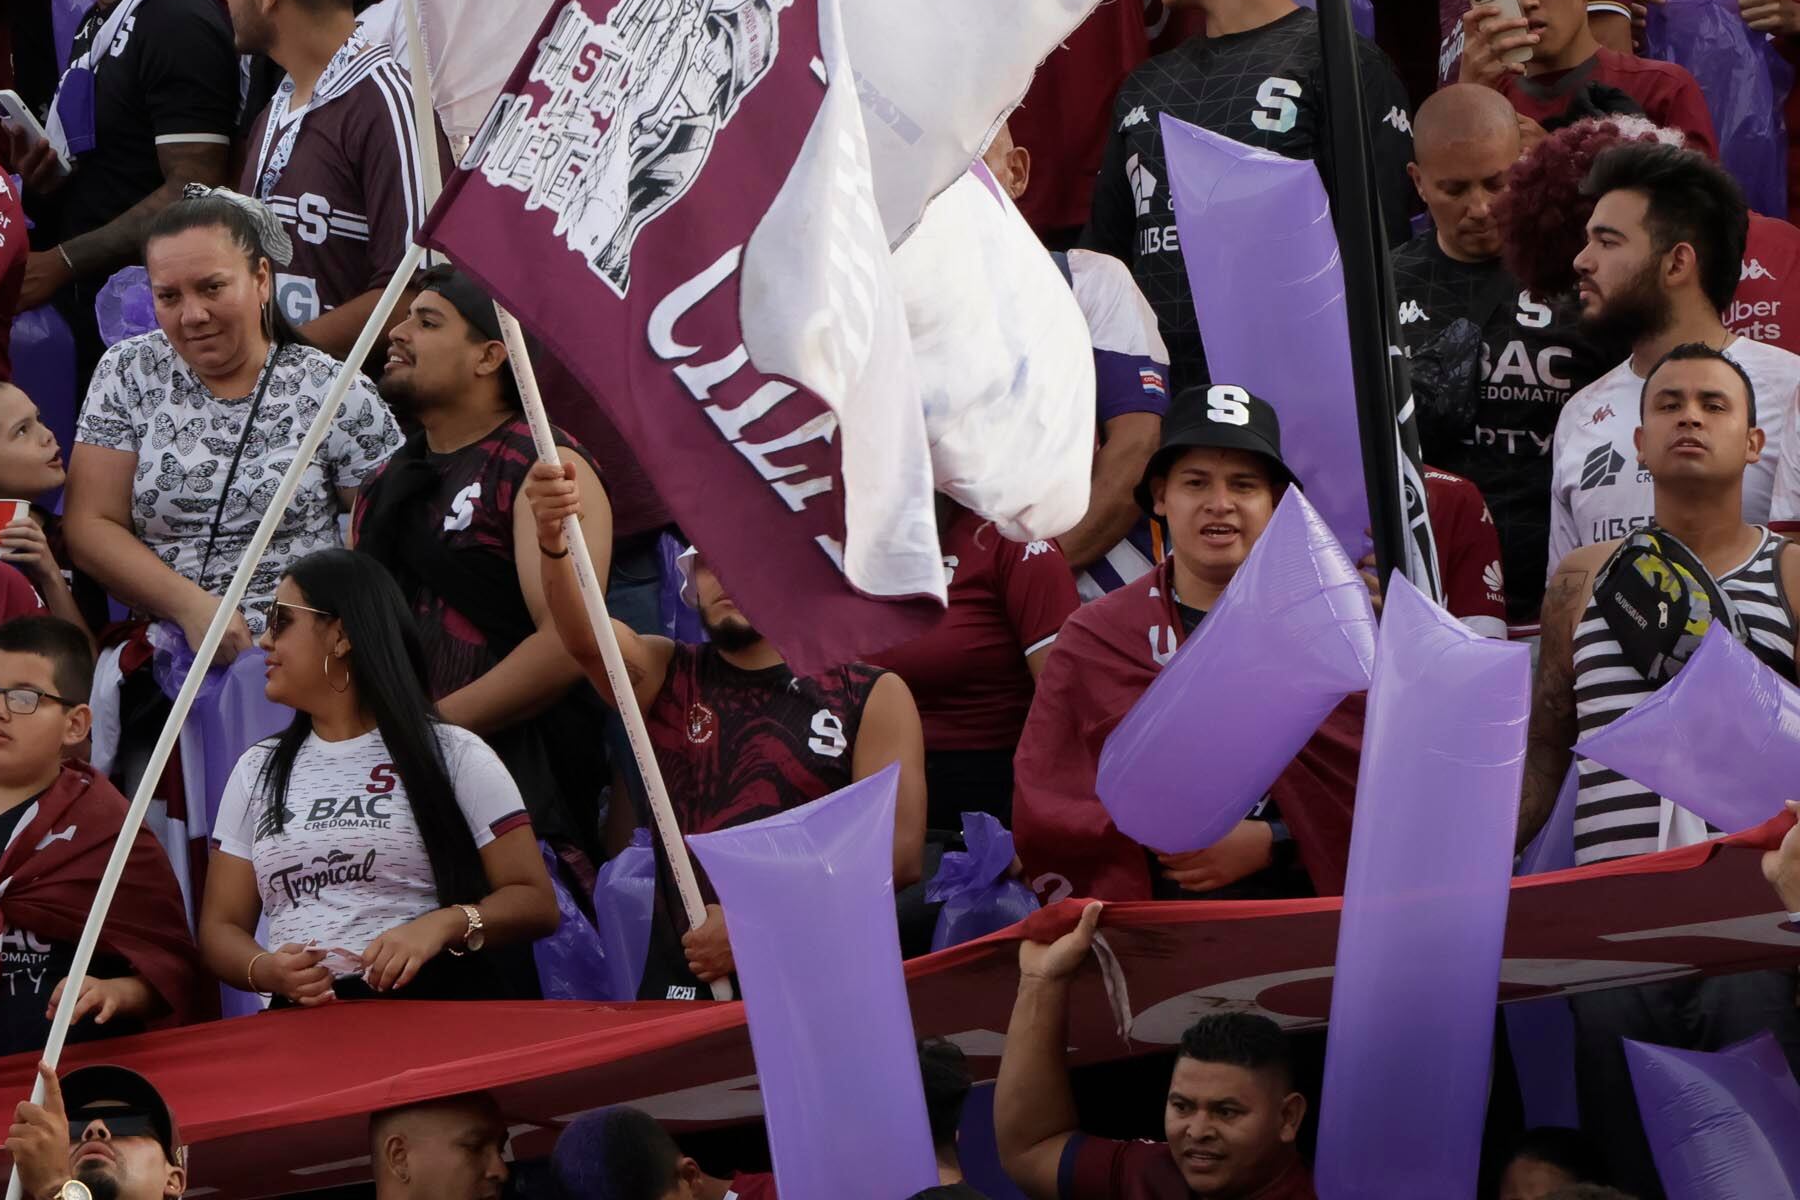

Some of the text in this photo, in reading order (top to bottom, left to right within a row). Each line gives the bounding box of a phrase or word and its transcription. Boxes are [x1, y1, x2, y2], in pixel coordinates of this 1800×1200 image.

[1252, 78, 1302, 132] S
[465, 93, 590, 205] MUERTE
[298, 192, 330, 243] S
[1516, 290, 1552, 328] S
[1207, 384, 1250, 426] S
[444, 482, 481, 531] S
[809, 710, 847, 758] S
[366, 763, 396, 794] S
[303, 817, 392, 831] CREDOMATIC
[304, 793, 393, 821] BAC
[269, 850, 377, 900] Tropical
